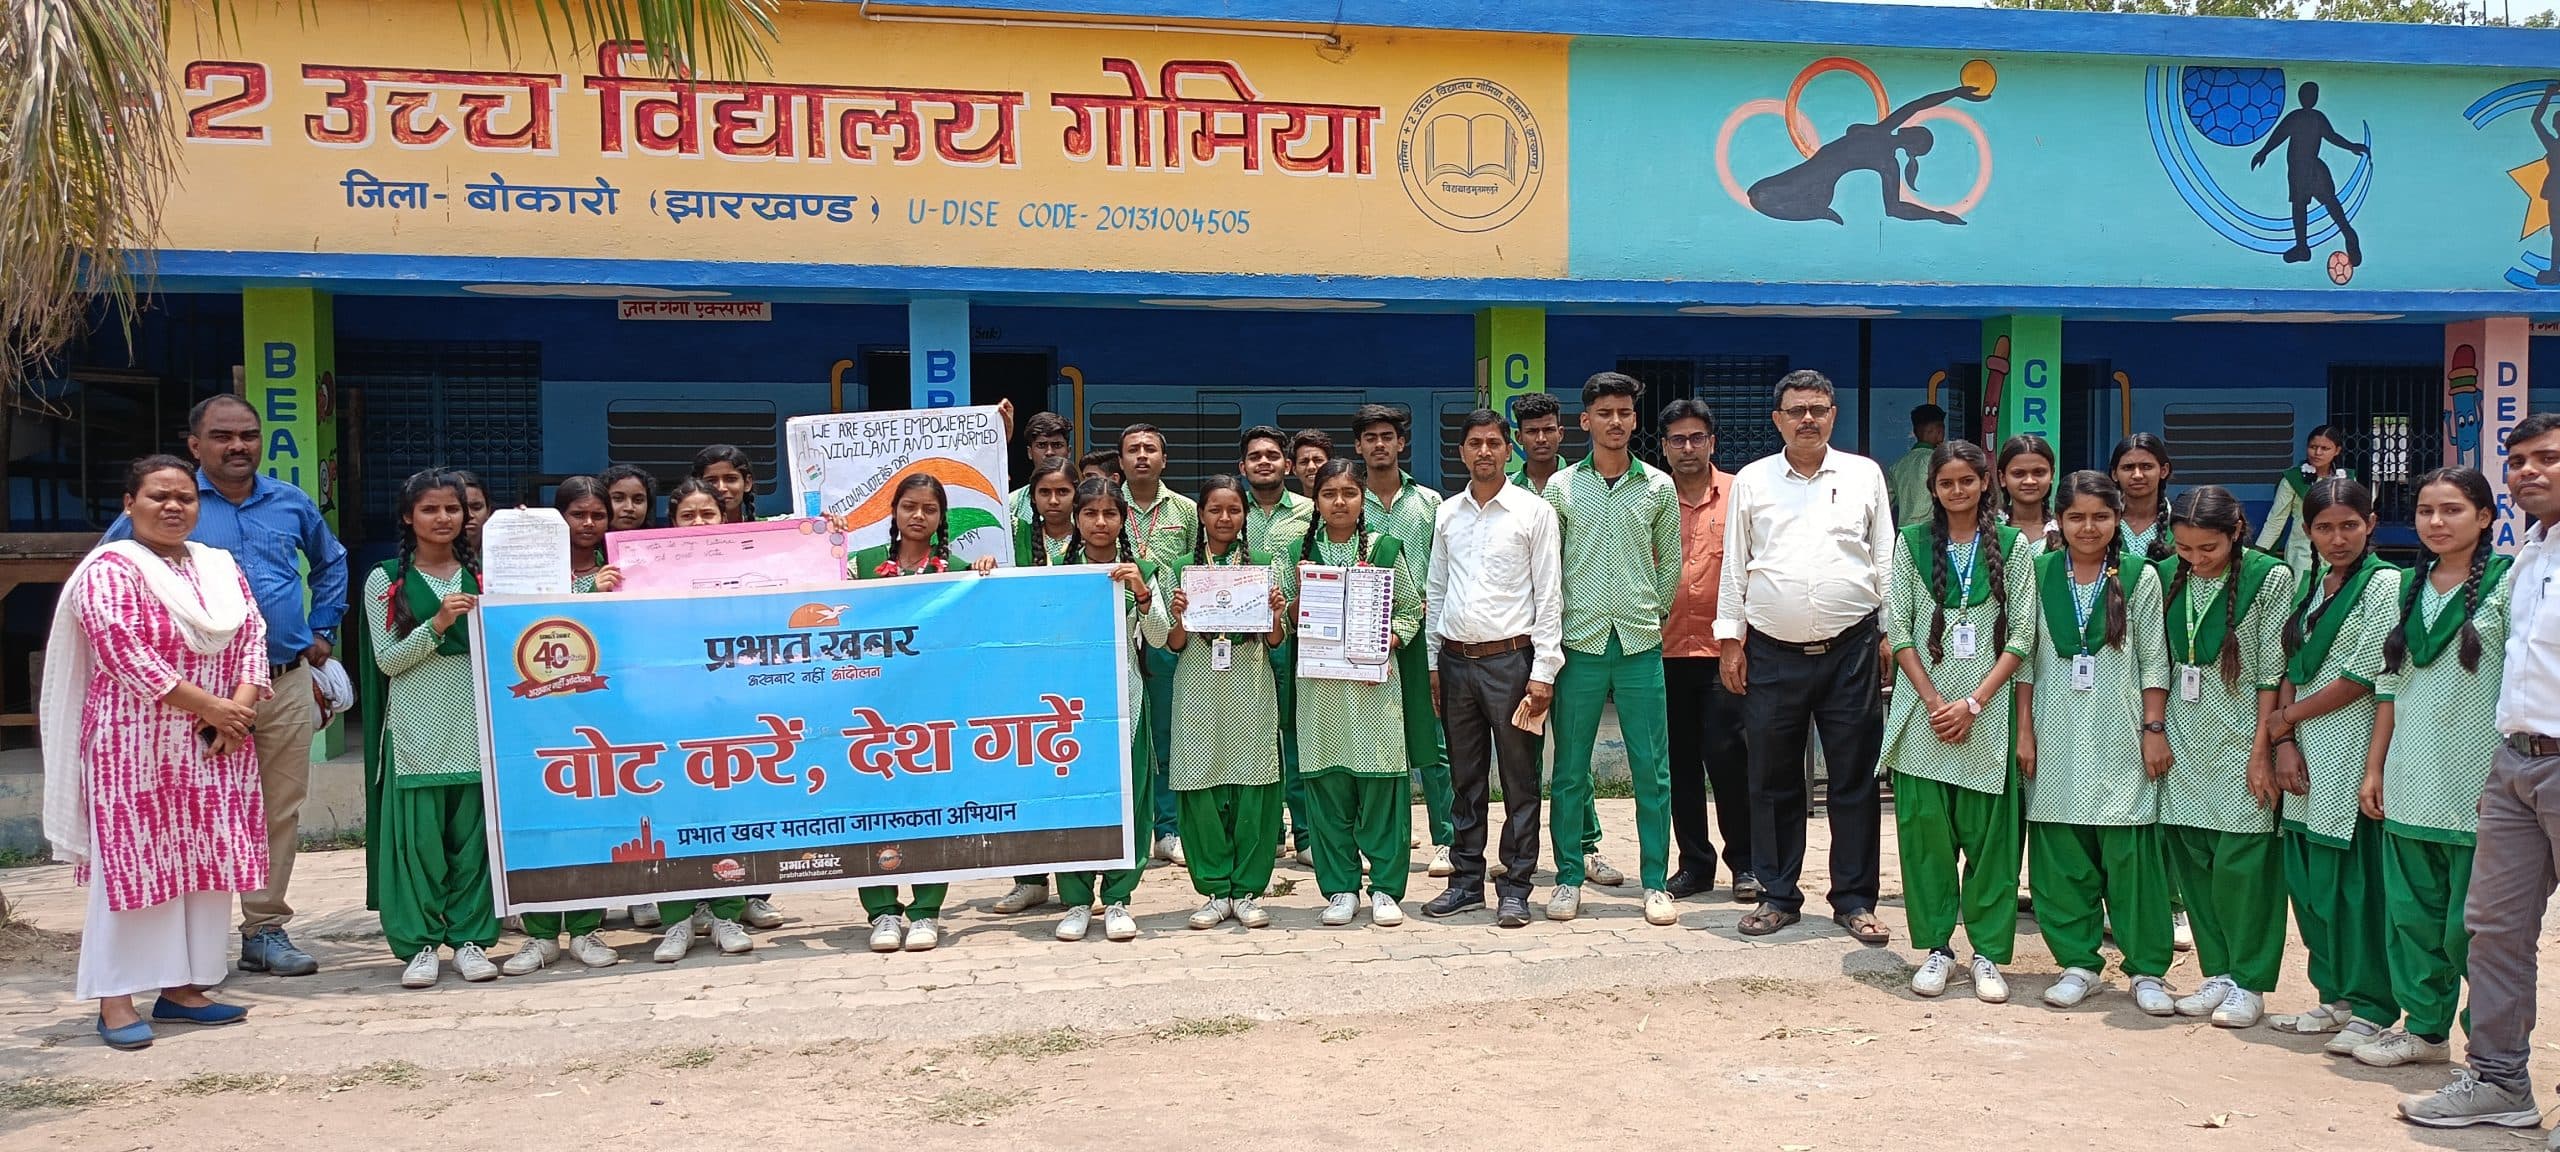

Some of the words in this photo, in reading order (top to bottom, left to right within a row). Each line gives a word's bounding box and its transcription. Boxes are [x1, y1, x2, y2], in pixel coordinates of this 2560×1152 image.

[185, 59, 272, 146] 2
[300, 62, 566, 157] उच्च
[583, 38, 1028, 170] विद्यालय
[1050, 57, 1386, 181] गोमिया
[464, 171, 621, 217] बोकारो
[908, 198, 1000, 227] U-DISE
[1096, 204, 1251, 235] 20131004505
[2023, 358, 2048, 437] CR
[811, 424, 831, 439] WE
[838, 422, 859, 441] ARE
[863, 420, 898, 442] SAFE
[904, 413, 988, 436] EMPOWERED
[820, 438, 901, 461] VIGILANT
[902, 435, 934, 454] AND
[937, 429, 999, 452] INFORMED
[533, 641, 570, 669] 40
[704, 632, 812, 672] प्रभात
[818, 625, 921, 661] खबर
[801, 667, 825, 684] नहीं
[535, 726, 667, 799] वोट
[678, 714, 826, 794] करें,
[841, 709, 957, 779] देश
[967, 694, 1085, 777] गढ़ें
[677, 825, 726, 846] प्रभात
[731, 821, 777, 842] खबर
[780, 815, 846, 838] मतदाता
[946, 800, 1018, 826] अभियान
[779, 860, 810, 871] प्रभात
[811, 857, 841, 868] खबर
